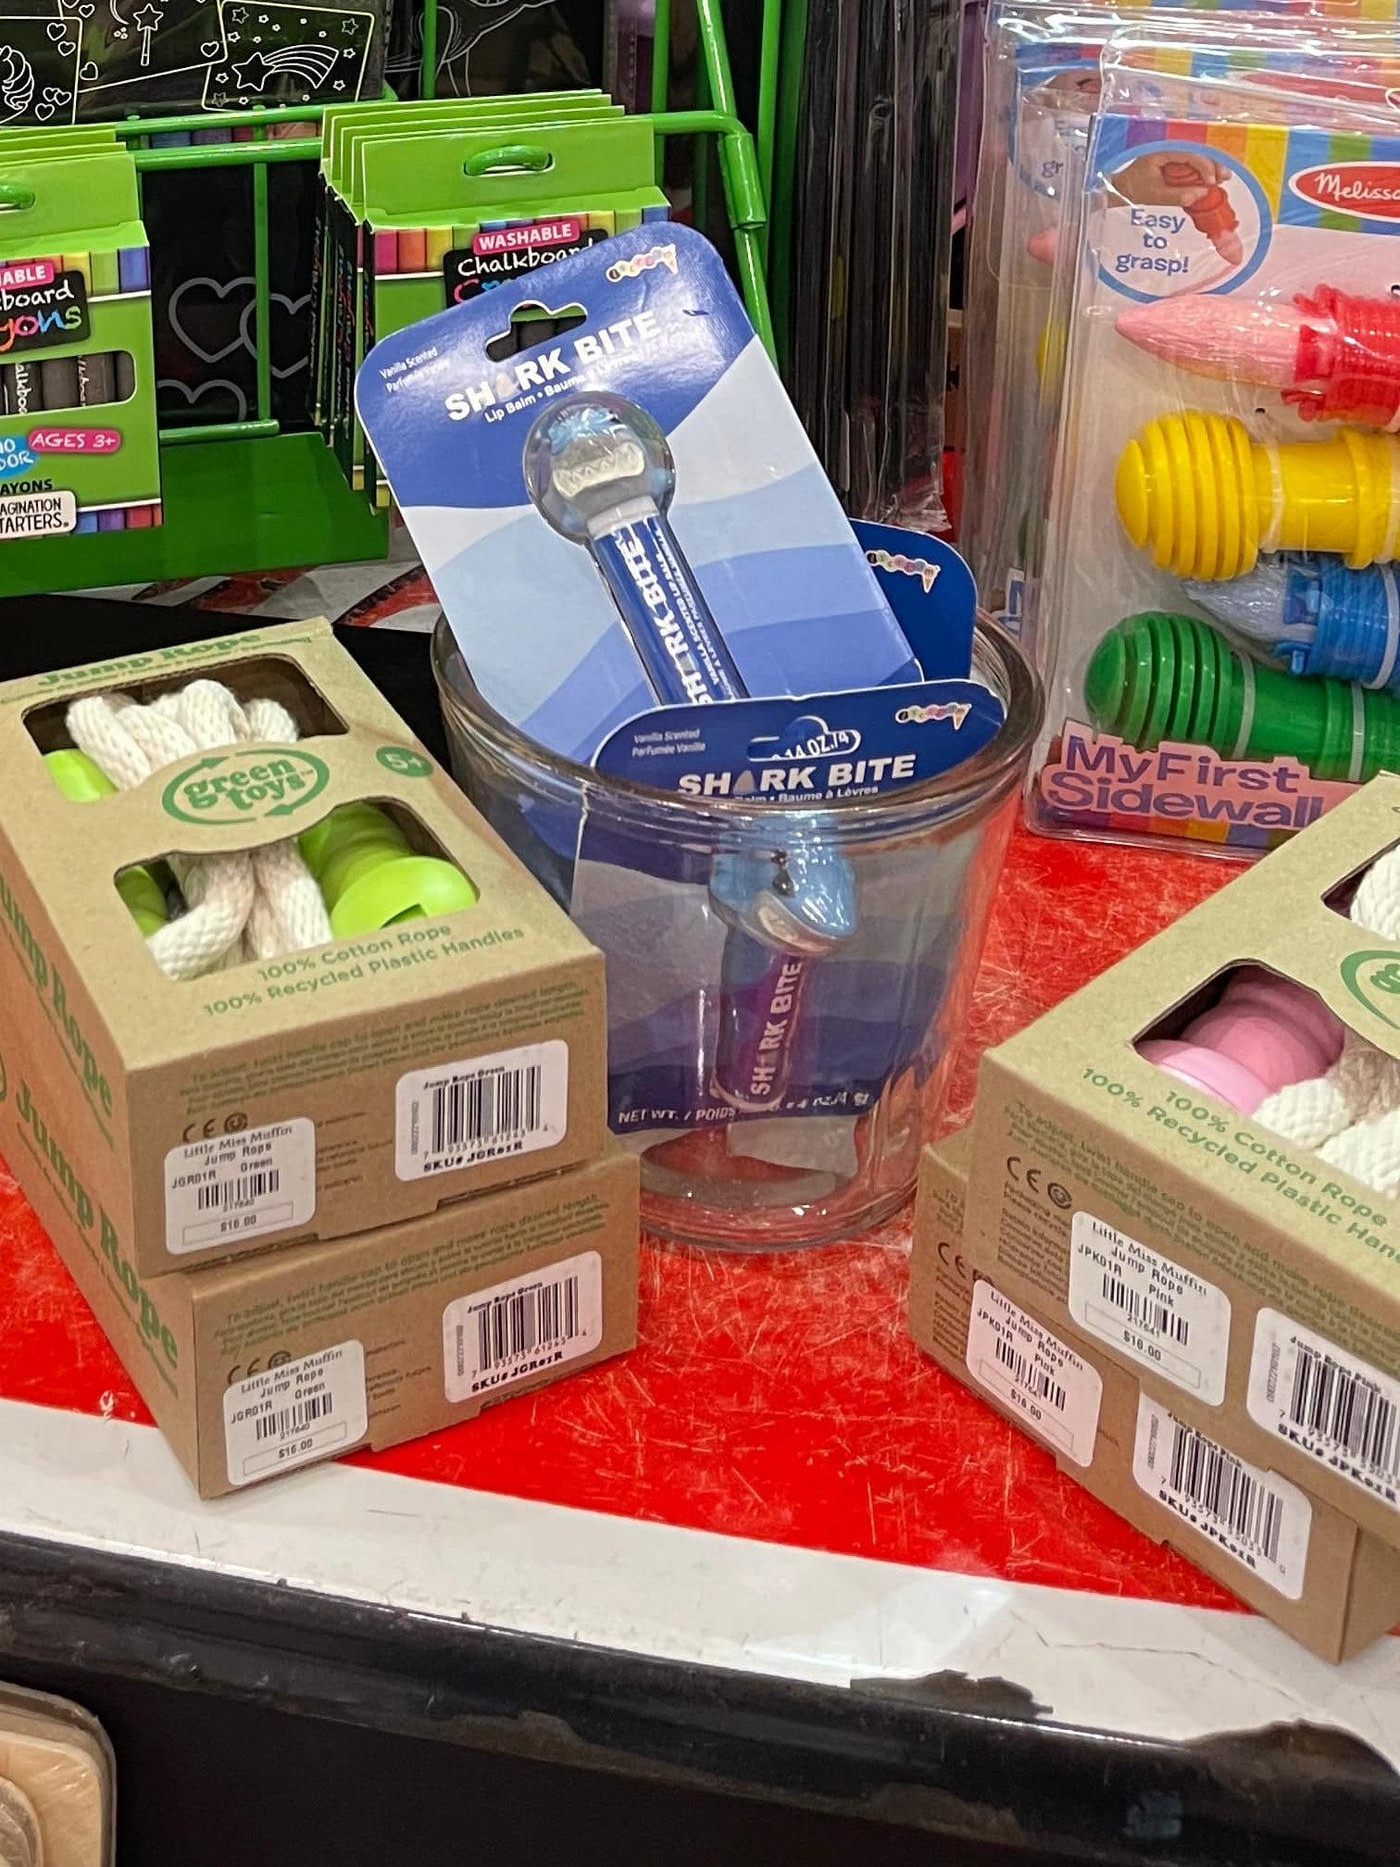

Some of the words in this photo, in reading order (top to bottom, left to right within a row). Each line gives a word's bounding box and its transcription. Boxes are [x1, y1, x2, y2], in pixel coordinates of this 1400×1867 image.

[478, 223, 572, 251] WASHABLE
[1130, 208, 1186, 233] Easy
[1143, 232, 1168, 250] to
[1115, 254, 1189, 276] grasp!
[574, 309, 662, 365] BITE
[31, 432, 85, 449] AGES
[93, 434, 117, 448] 3+
[38, 656, 154, 688] Jump
[159, 633, 261, 661] Rope
[386, 750, 424, 772] 5+
[828, 755, 916, 787] BITE
[182, 755, 300, 809] green
[228, 775, 306, 812] toys
[257, 952, 316, 982] 100%
[321, 938, 394, 966] Cotton
[399, 923, 451, 950] Rope
[202, 992, 262, 1017] 100%
[267, 965, 365, 1001] Recycled
[369, 947, 439, 975] Plastic
[444, 926, 525, 957] Handles
[771, 963, 802, 1015] BITE
[184, 1142, 215, 1159] Little
[219, 1136, 247, 1151] Miss
[250, 1124, 293, 1143] Muffin
[204, 1151, 236, 1166] Jump
[242, 1143, 271, 1156] Rope
[1081, 1067, 1143, 1109] 100%
[1146, 1105, 1258, 1176] Recycled
[1260, 1170, 1344, 1227] Plastic
[1165, 1089, 1228, 1134] 100%
[1233, 1131, 1319, 1186] Cotton
[1321, 1180, 1389, 1228] Rope
[15, 1077, 95, 1230] Jump
[97, 1214, 181, 1370] Rope
[1092, 1221, 1124, 1248] Little
[1127, 1241, 1159, 1266] Miss
[1162, 1261, 1208, 1297] Muffin
[1110, 1245, 1146, 1275] Jump
